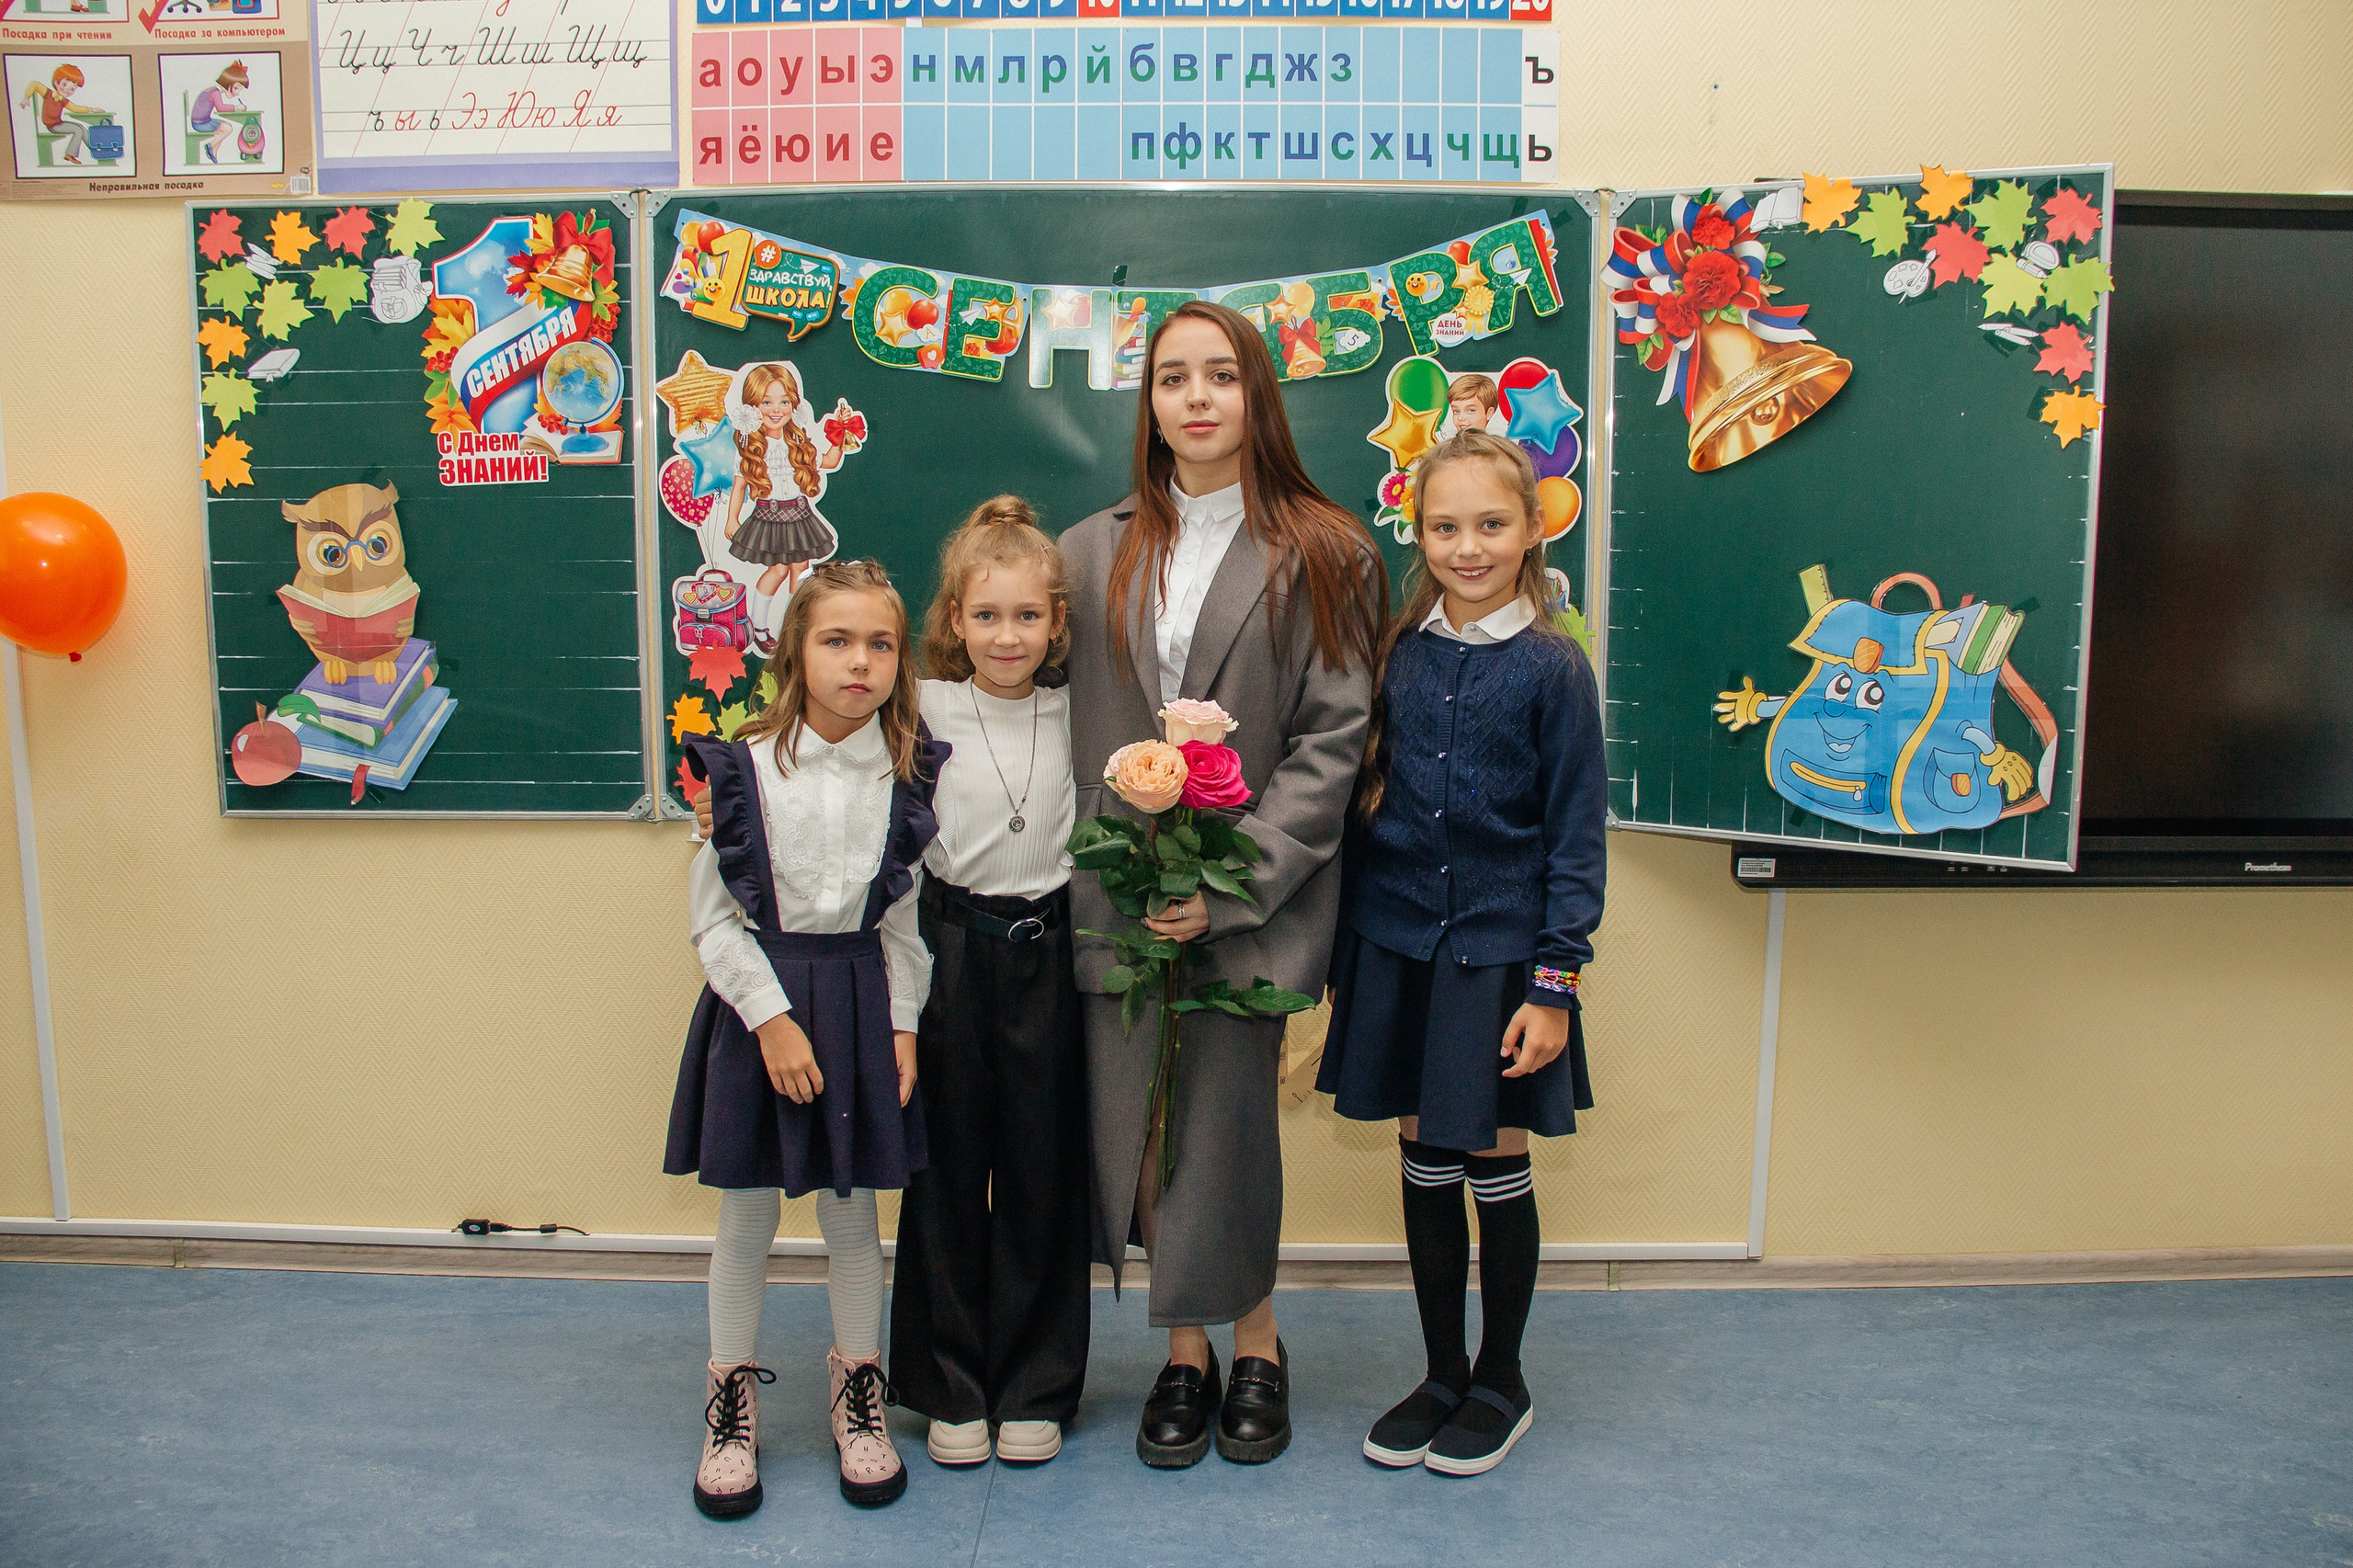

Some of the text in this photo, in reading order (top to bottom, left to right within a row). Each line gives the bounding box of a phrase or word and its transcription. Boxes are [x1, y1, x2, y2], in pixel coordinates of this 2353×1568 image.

[2, 28, 112, 41] Посадка при чтении
[154, 28, 285, 40] Посадка за компьютером
[89, 182, 160, 193] Неправильная
[748, 268, 833, 291] ЗДРАВСТВУЙ,
[745, 285, 832, 309] ШКОЛА!
[1435, 328, 1465, 336] ЗНАНИЙ
[1438, 320, 1462, 328] ДЕНЬ
[466, 306, 577, 399] СЕНТЯБРЯ
[458, 432, 519, 457] Днем
[439, 450, 547, 484] ЗНАНИЙ!
